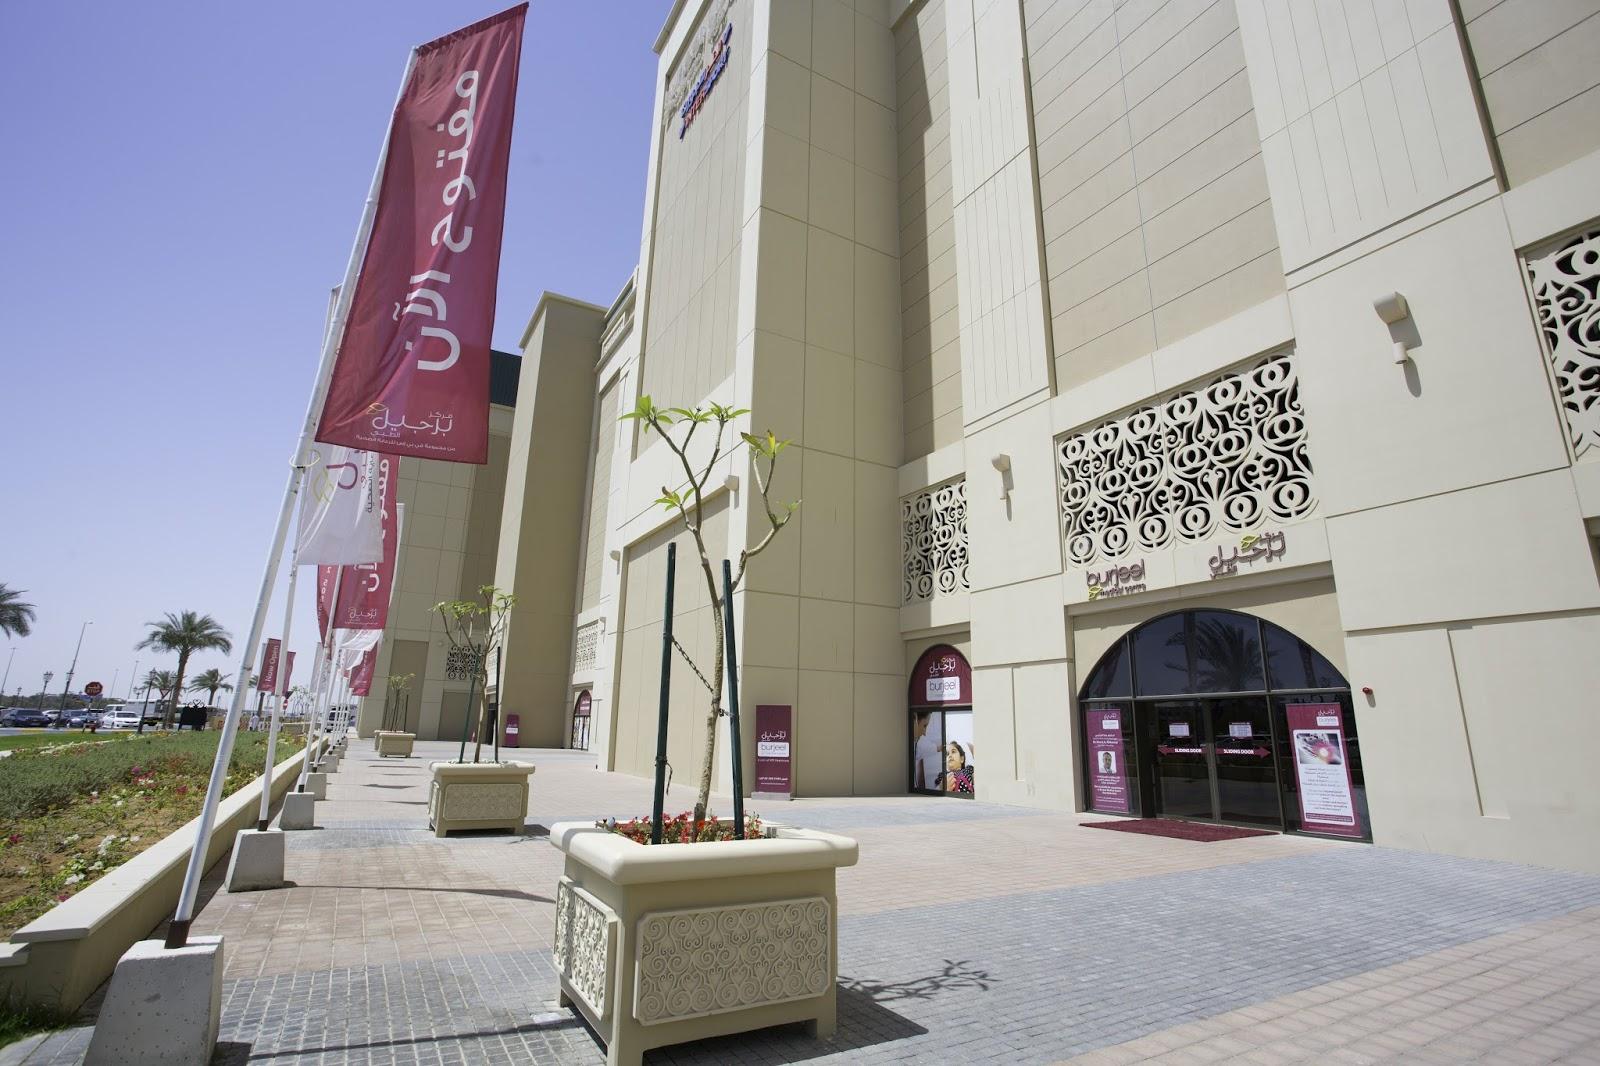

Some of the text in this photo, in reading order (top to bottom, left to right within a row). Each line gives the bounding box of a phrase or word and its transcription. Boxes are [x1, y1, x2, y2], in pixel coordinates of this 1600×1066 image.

[392, 68, 480, 373] مفتوح الآن
[371, 408, 453, 437] برجيل
[1208, 535, 1286, 570] برجيل
[1086, 558, 1146, 588] burjeel
[264, 645, 280, 682] Now Open
[929, 680, 956, 693] burjeel
